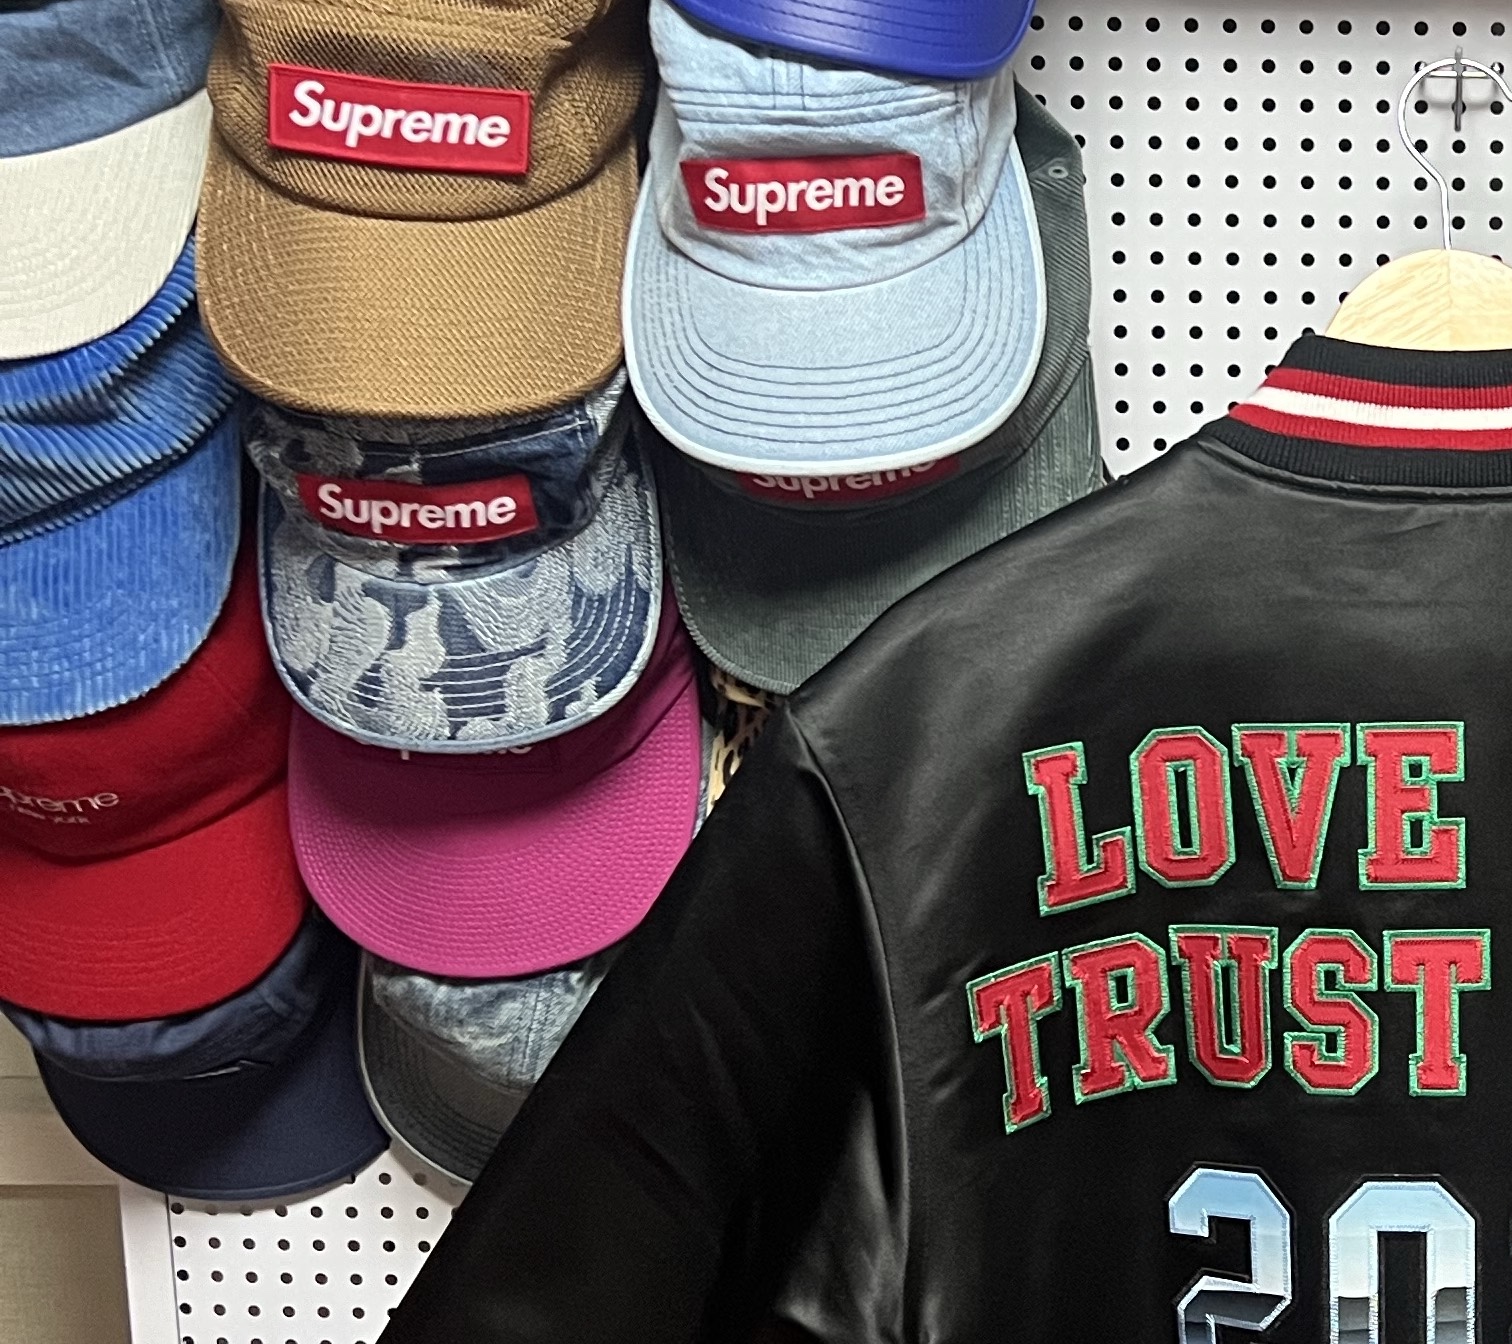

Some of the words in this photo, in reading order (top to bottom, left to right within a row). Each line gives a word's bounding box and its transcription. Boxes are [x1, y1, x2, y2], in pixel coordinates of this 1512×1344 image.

[289, 80, 511, 155] Supreme
[703, 168, 905, 226] Supreme
[318, 485, 517, 536] Supreme
[1022, 722, 1466, 916] LOVE
[966, 924, 1491, 1133] TRUST
